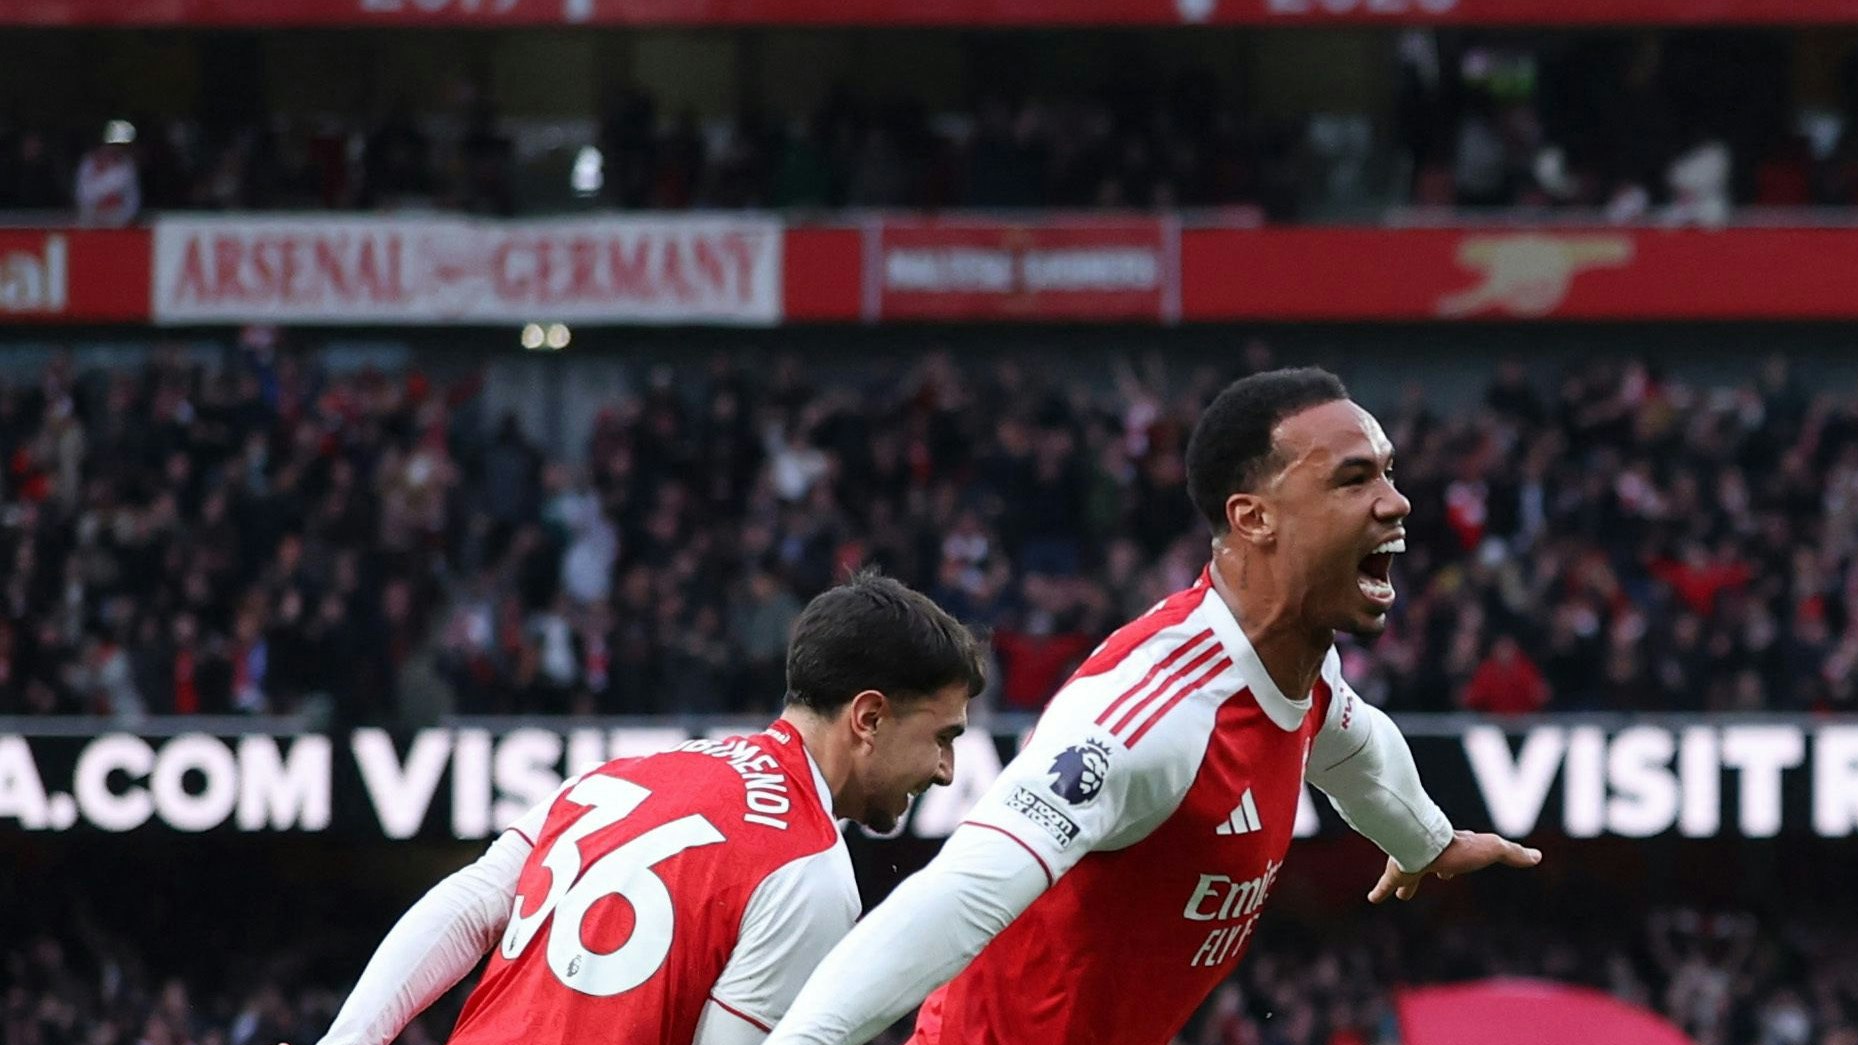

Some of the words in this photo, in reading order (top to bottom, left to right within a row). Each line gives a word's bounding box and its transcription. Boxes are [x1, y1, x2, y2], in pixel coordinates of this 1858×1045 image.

[172, 235, 413, 304] ARSENAL
[492, 235, 758, 304] GERMANY
[501, 773, 728, 997] 36
[1190, 924, 1242, 967] FLY
